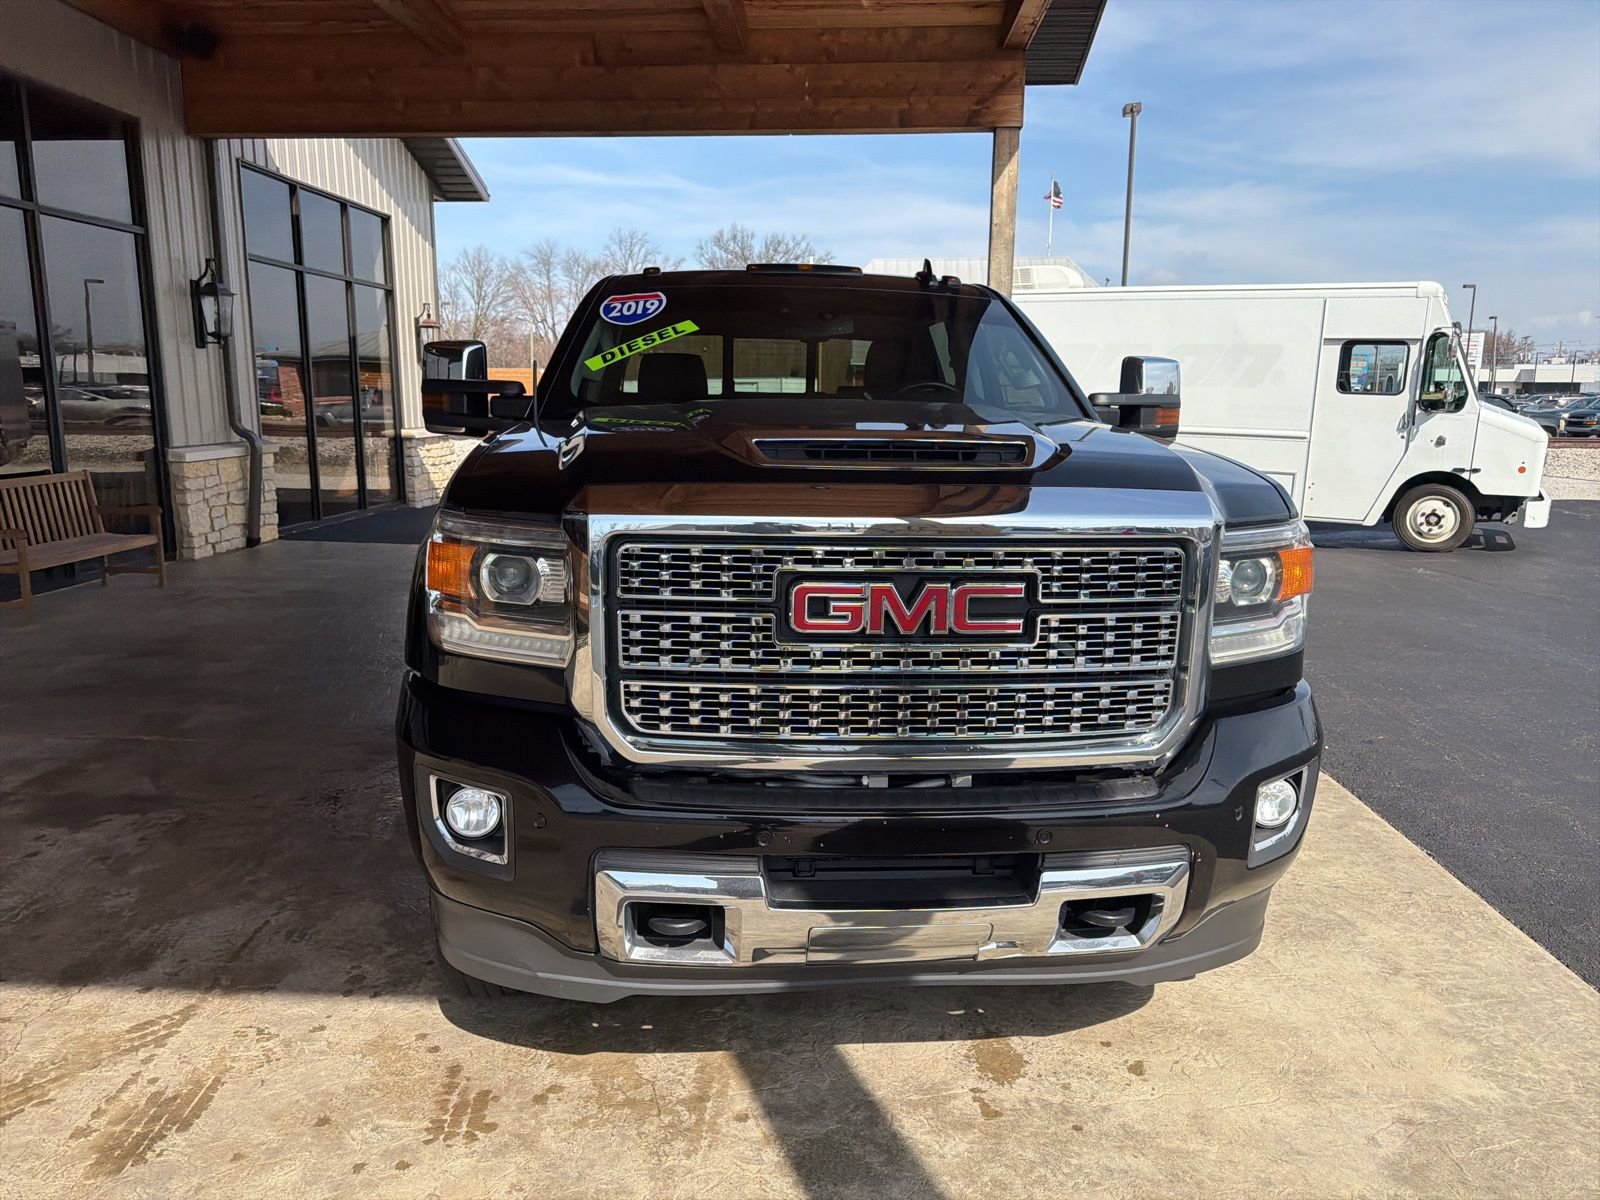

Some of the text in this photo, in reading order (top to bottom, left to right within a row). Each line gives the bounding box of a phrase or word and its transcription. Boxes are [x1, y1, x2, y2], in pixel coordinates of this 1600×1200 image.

[608, 300, 659, 317] 2019
[601, 326, 685, 364] DIESEL
[790, 582, 1026, 635] GMC
